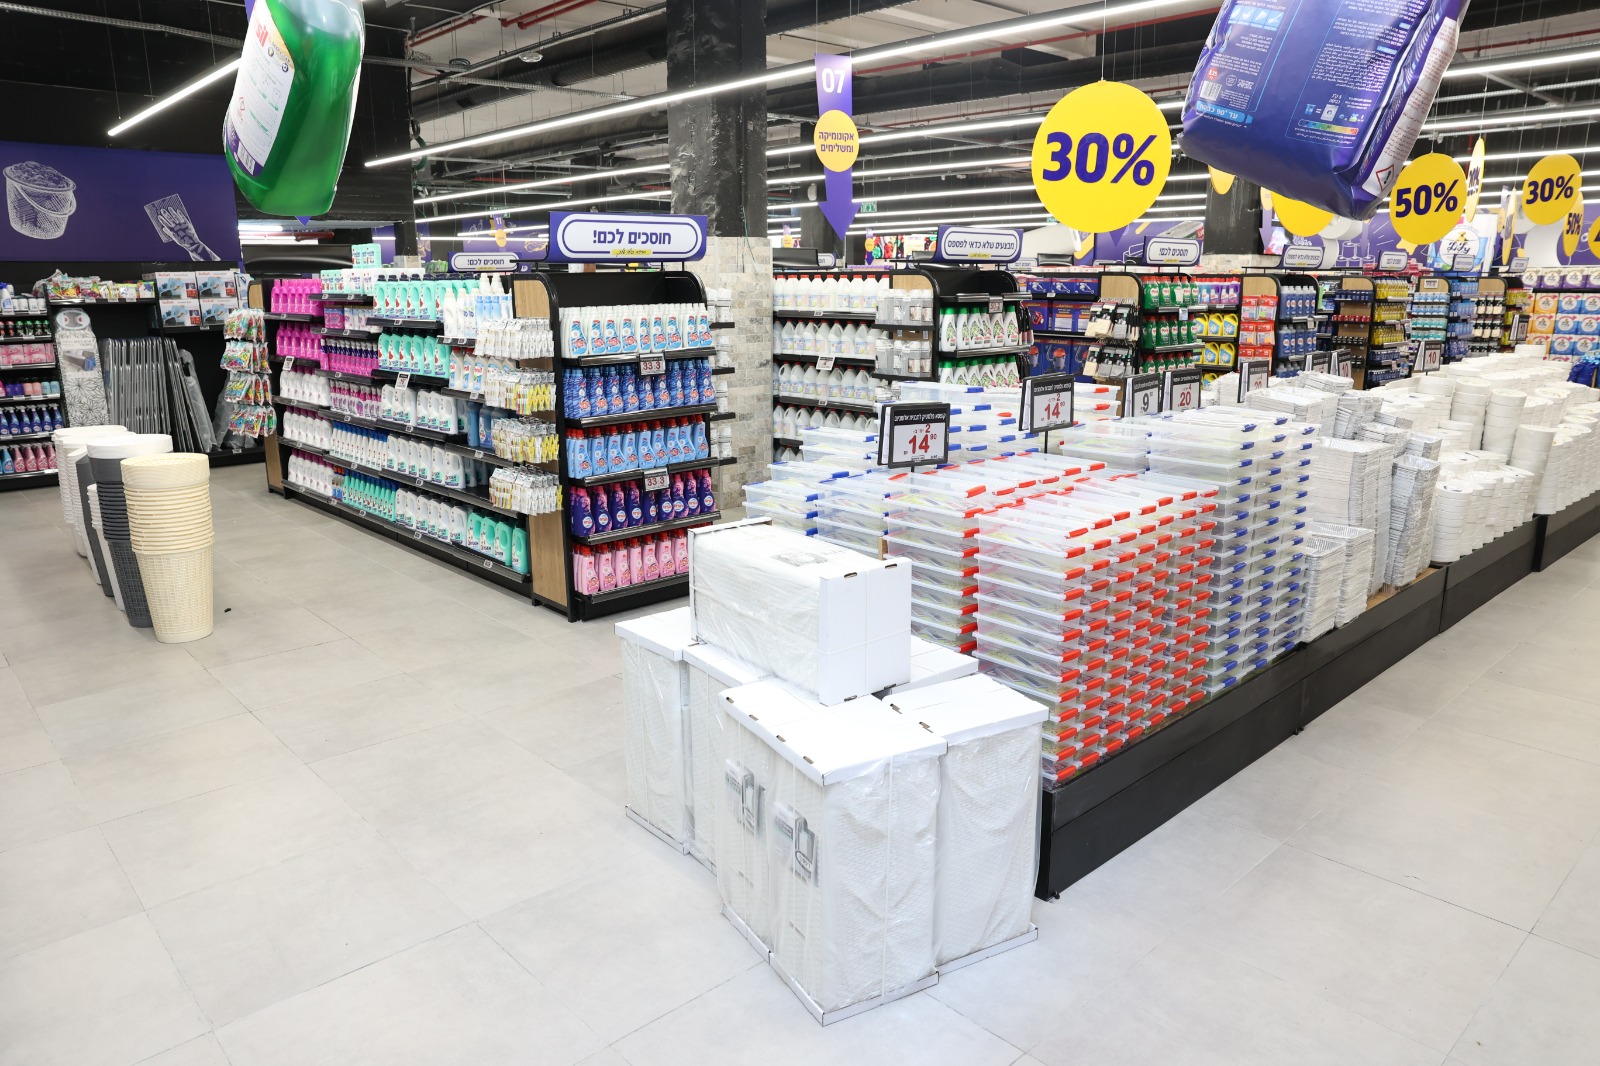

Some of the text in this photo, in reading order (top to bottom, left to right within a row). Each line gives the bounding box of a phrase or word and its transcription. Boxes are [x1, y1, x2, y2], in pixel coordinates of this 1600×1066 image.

[821, 67, 846, 94] 07
[818, 131, 854, 142] אקונומיקה
[820, 143, 854, 153] ומשלימים
[1042, 131, 1158, 187] 30%
[1525, 174, 1576, 205] 30%
[1395, 179, 1460, 218] 50%
[495, 217, 502, 225] 11
[593, 228, 672, 245] חוסכים לכם!
[947, 239, 967, 248] לפספס
[969, 241, 981, 249] כדאי
[981, 240, 994, 249] שלא
[1171, 248, 1189, 257] חוסכים
[467, 257, 481, 266] לכם!
[1428, 351, 1437, 364] 10
[643, 361, 653, 371] 33
[1056, 393, 1061, 401] 2
[1180, 391, 1192, 407] 20
[1142, 393, 1150, 412] 9
[1044, 402, 1061, 421] 14
[925, 423, 931, 433] 2
[908, 433, 930, 455] 14
[647, 477, 658, 487] 33
